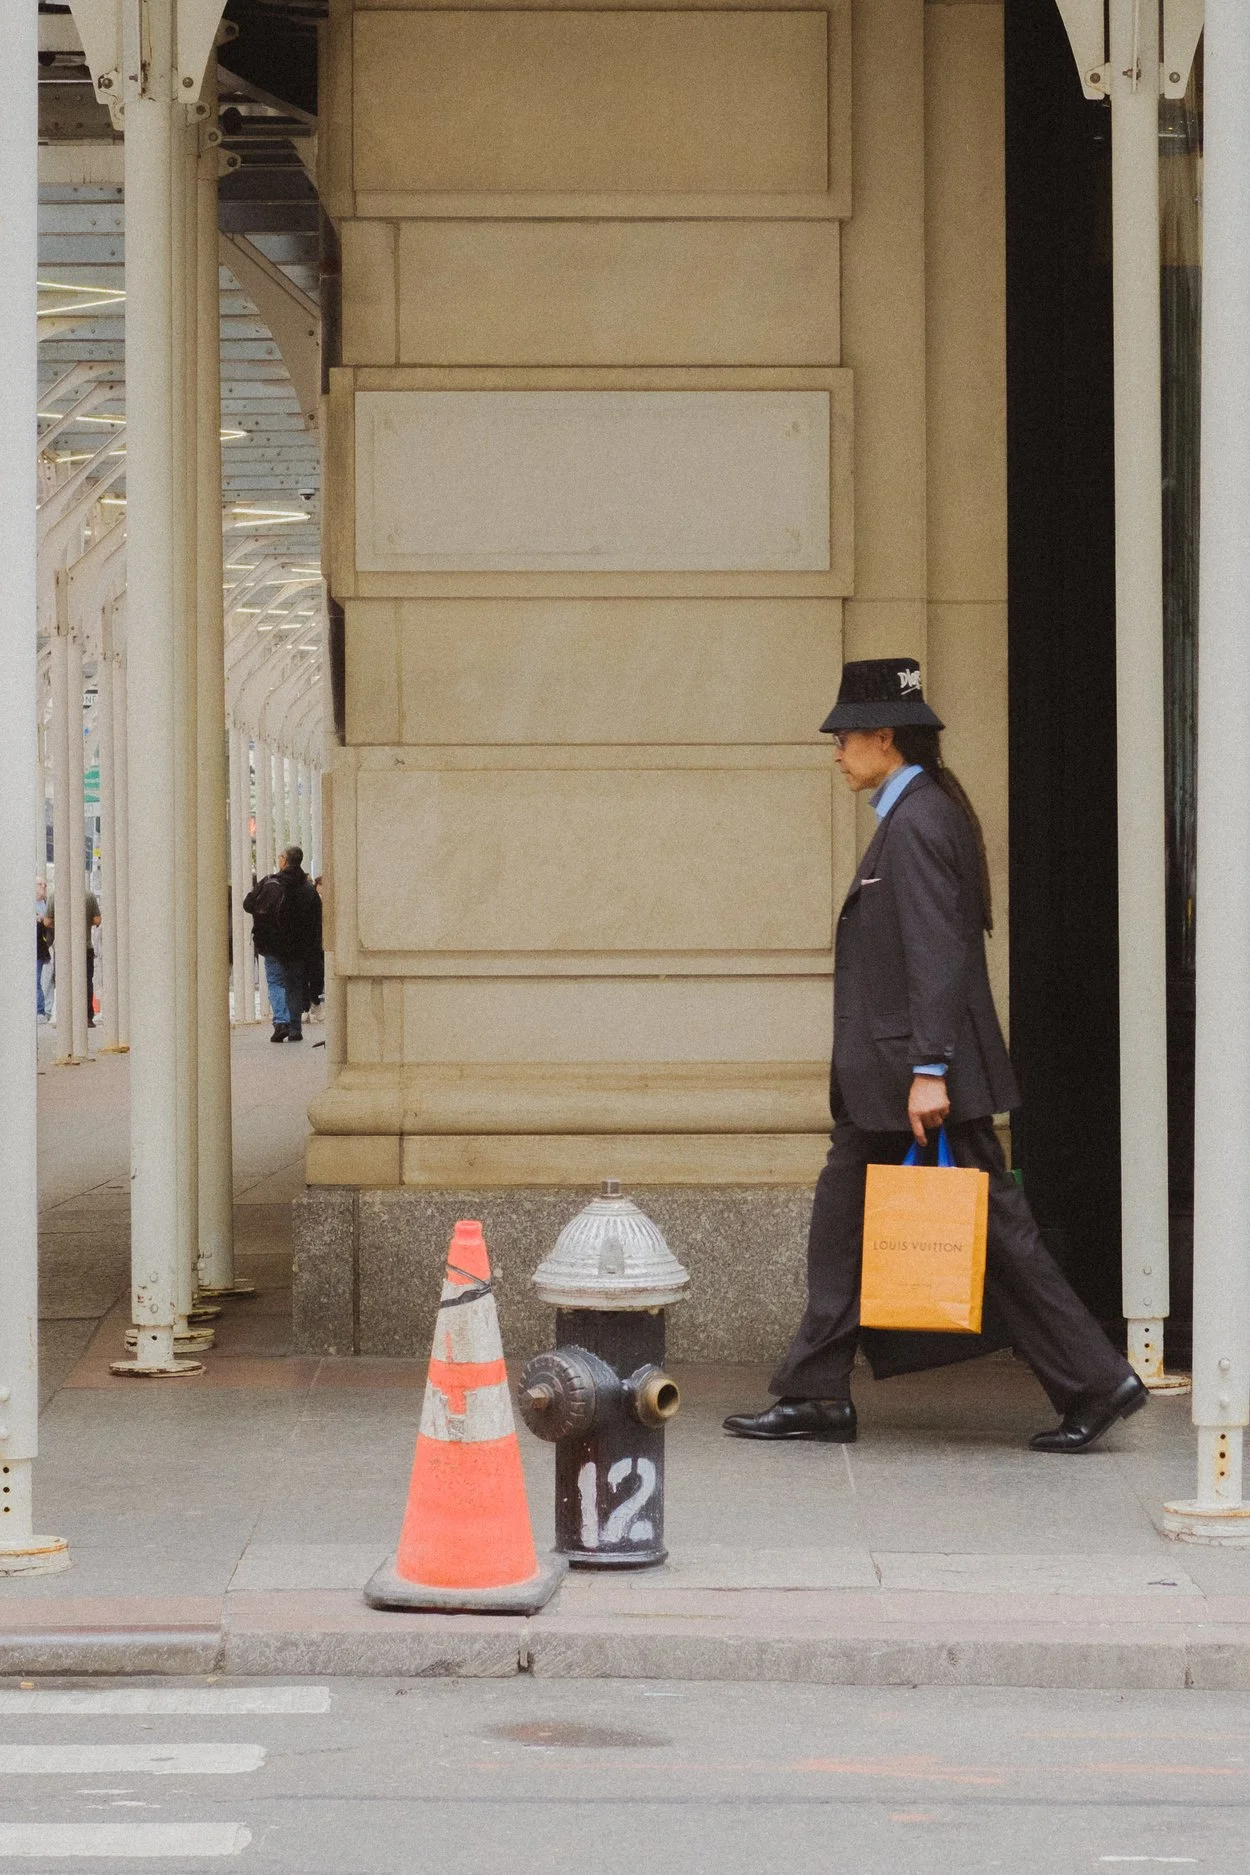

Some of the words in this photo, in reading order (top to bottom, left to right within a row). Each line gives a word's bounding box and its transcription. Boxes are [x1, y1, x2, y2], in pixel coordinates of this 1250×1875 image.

[873, 1240, 908, 1251] LOUIS
[911, 1241, 963, 1253] VUITTON
[577, 1457, 657, 1549] 12
